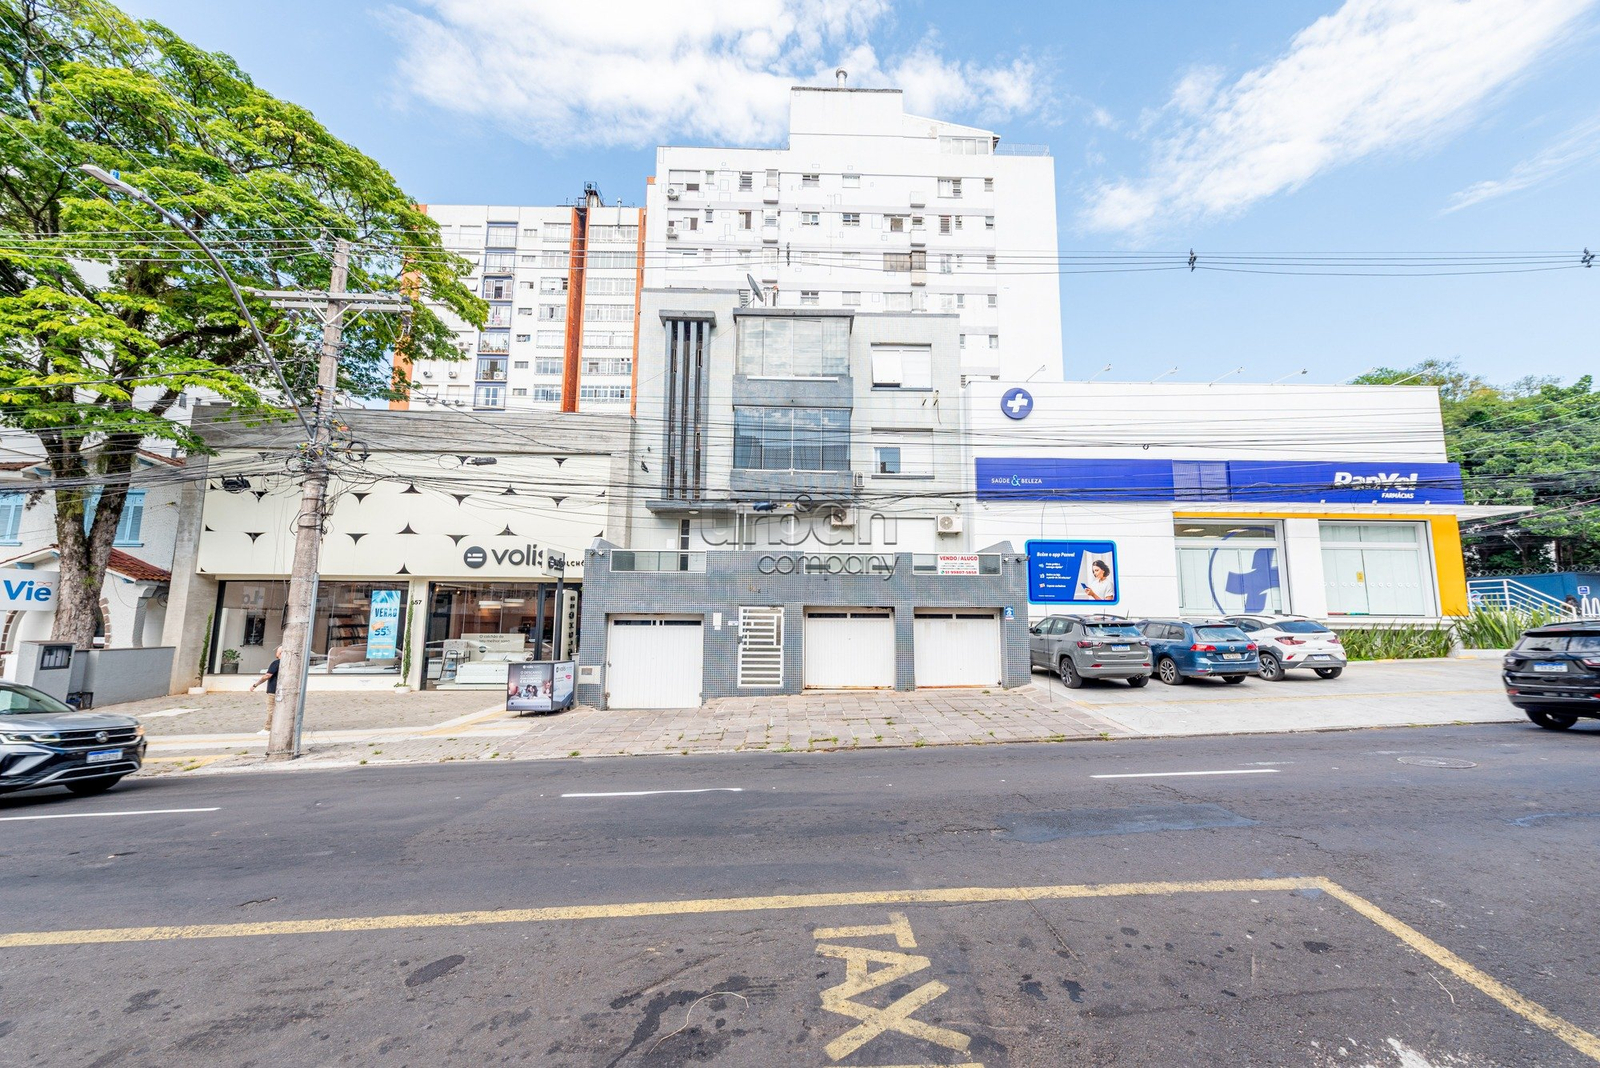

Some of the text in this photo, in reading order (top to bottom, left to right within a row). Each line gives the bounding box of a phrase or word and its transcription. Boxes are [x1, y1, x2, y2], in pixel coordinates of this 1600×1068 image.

[1011, 474, 1021, 487] &
[1381, 491, 1414, 499] FARMÁCIAS
[3, 579, 52, 602] Vie
[813, 911, 985, 1068] TAX
